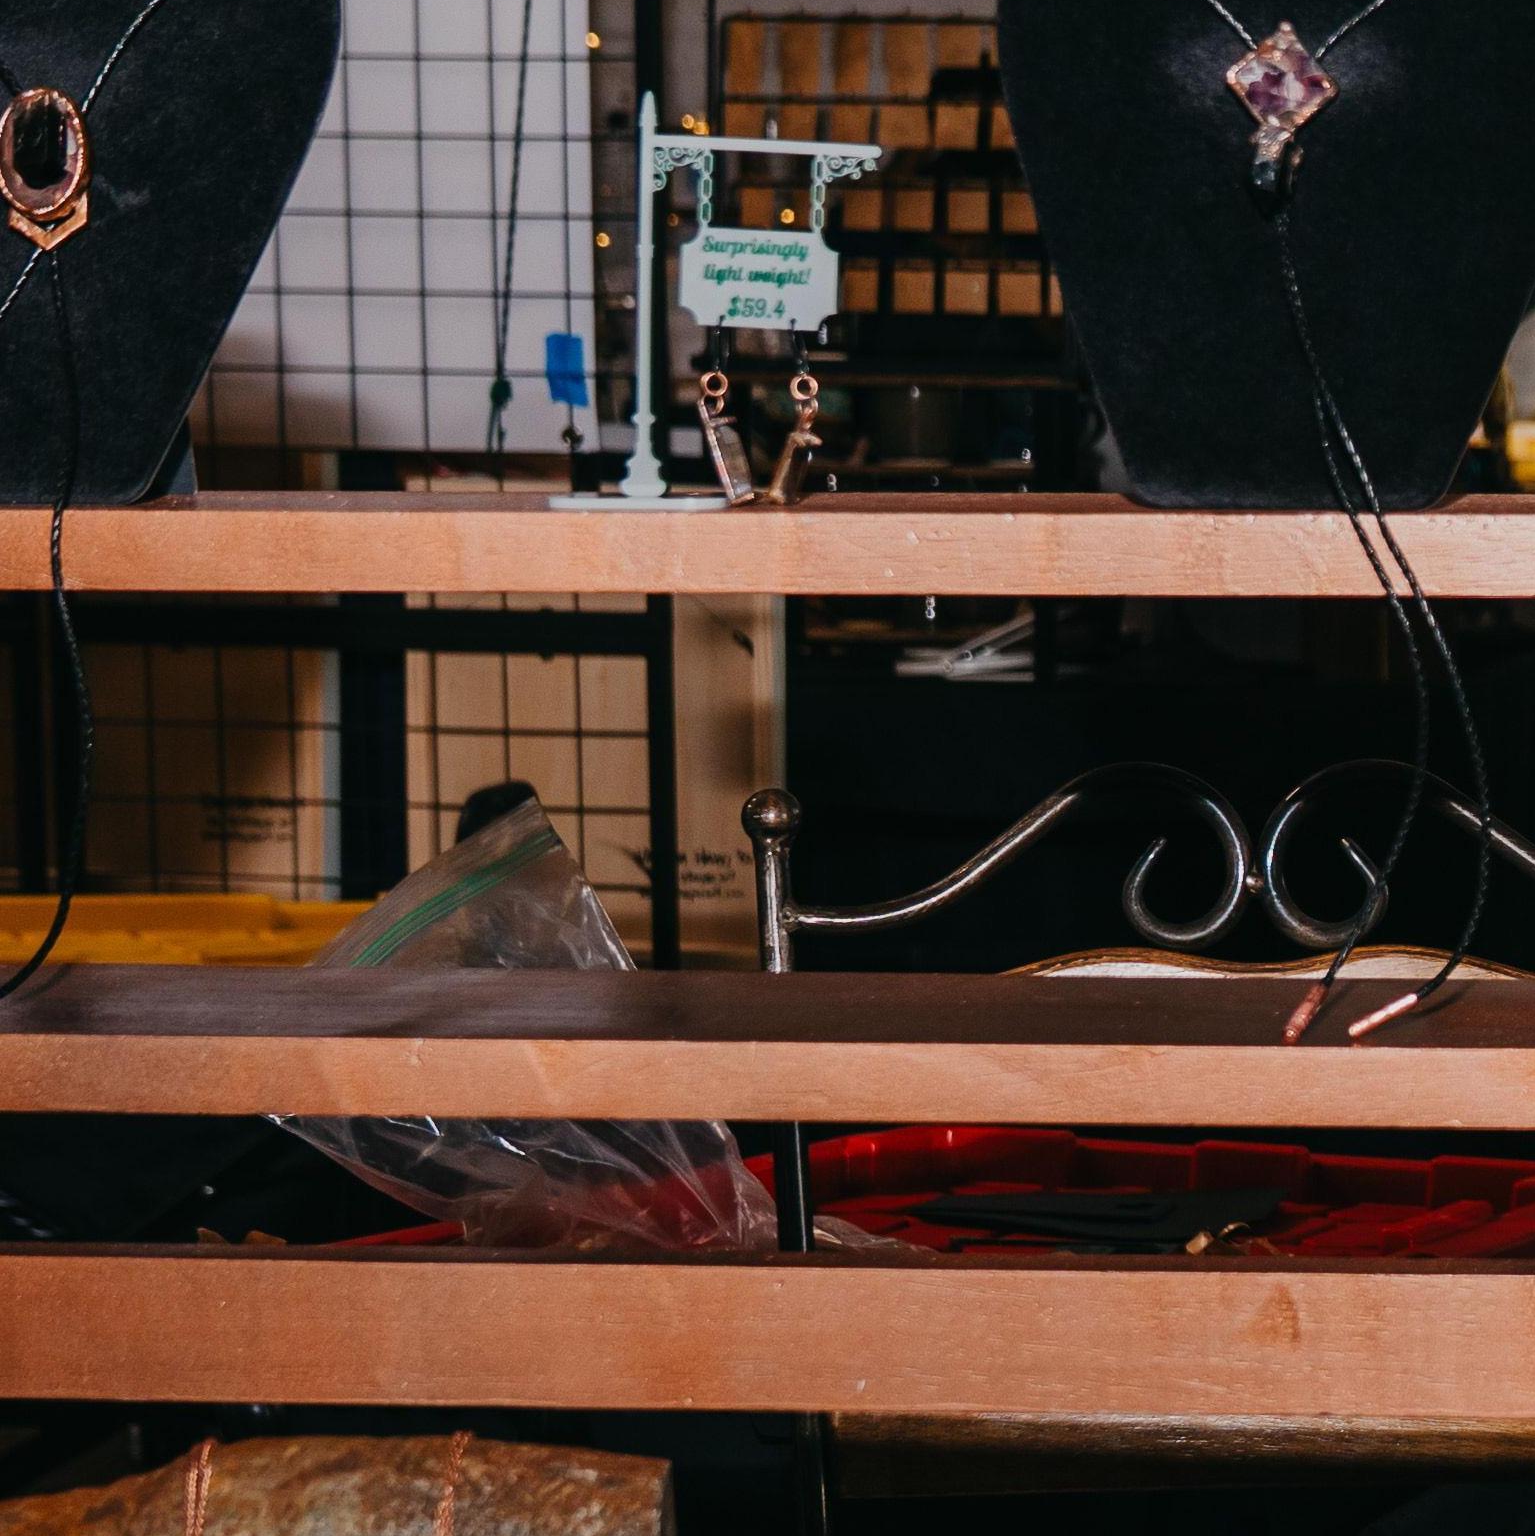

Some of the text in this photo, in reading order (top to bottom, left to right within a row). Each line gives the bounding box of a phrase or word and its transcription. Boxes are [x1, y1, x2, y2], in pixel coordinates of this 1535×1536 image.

[702, 235, 809, 261] Surprisingly
[703, 264, 812, 289] light weight!
[727, 295, 786, 319] $59.4
